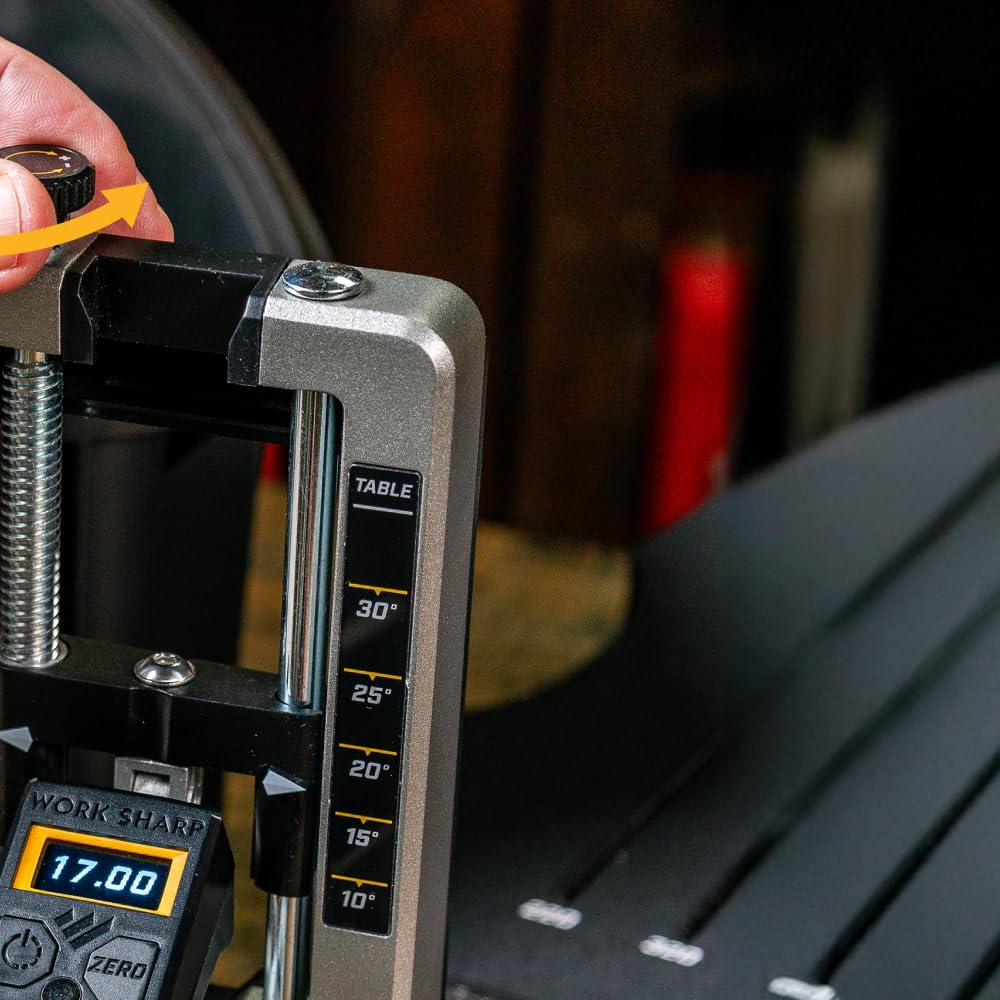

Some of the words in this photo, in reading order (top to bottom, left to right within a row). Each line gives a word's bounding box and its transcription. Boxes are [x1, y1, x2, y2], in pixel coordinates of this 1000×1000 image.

[355, 477, 413, 499] TABLE
[356, 599, 398, 620] 30°
[351, 683, 392, 705] 25°
[349, 759, 390, 780] 20°
[31, 791, 111, 822] WORK
[117, 807, 206, 836] SHARP
[346, 827, 379, 847] 15°
[51, 855, 159, 896] 17.00
[342, 890, 376, 910] 10°
[87, 956, 148, 980] ZERO
